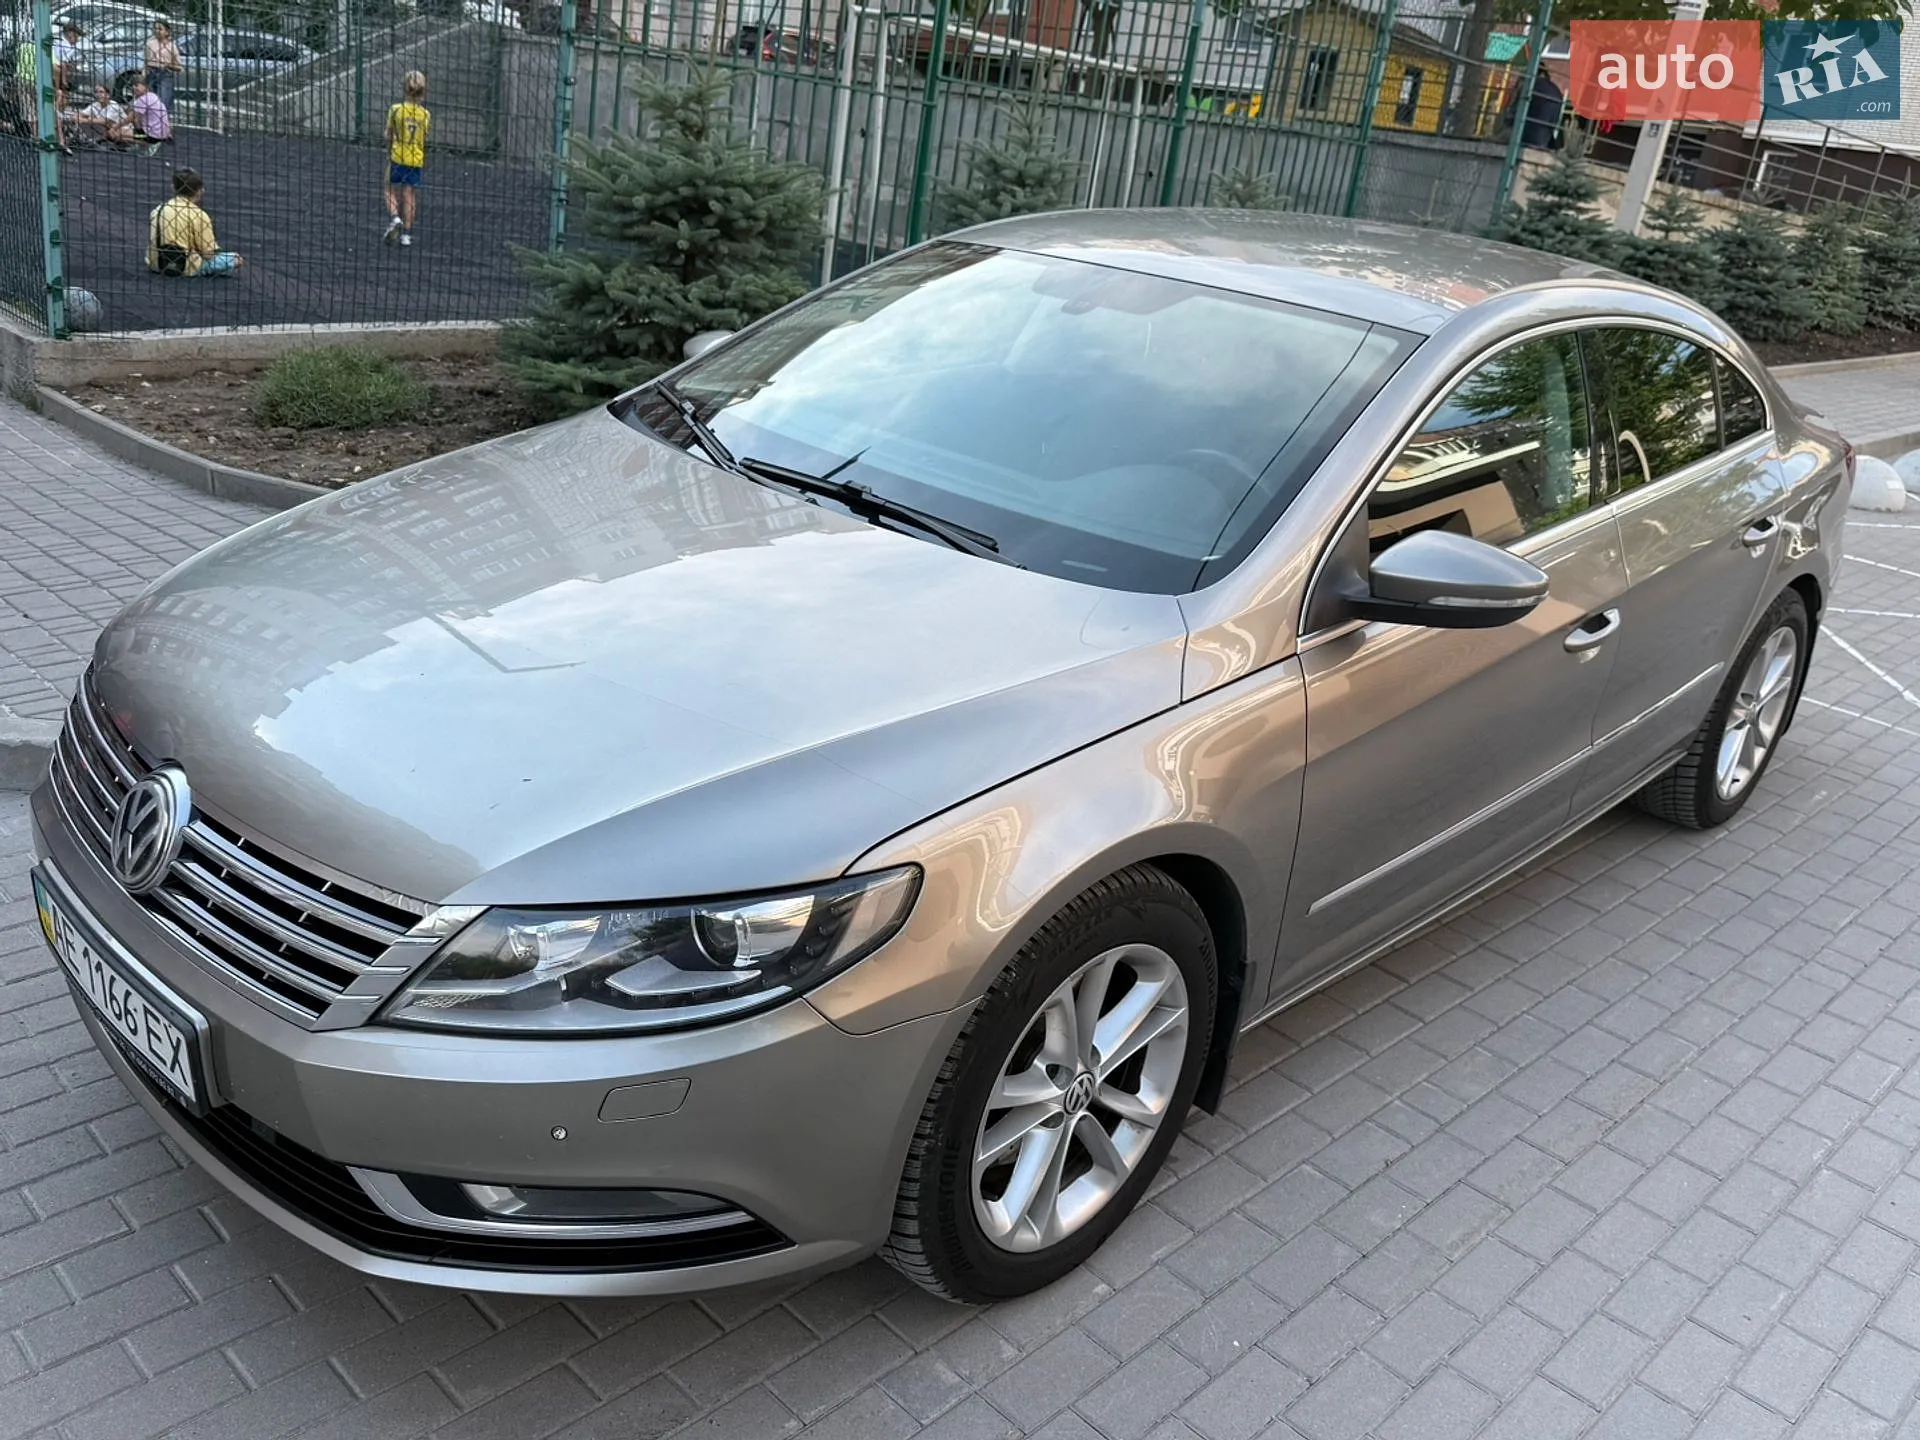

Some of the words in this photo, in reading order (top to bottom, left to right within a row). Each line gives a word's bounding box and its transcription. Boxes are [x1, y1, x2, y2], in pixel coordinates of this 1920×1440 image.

[53, 903, 80, 974] AE
[83, 946, 138, 1037] 1166
[143, 1003, 188, 1086] EX
